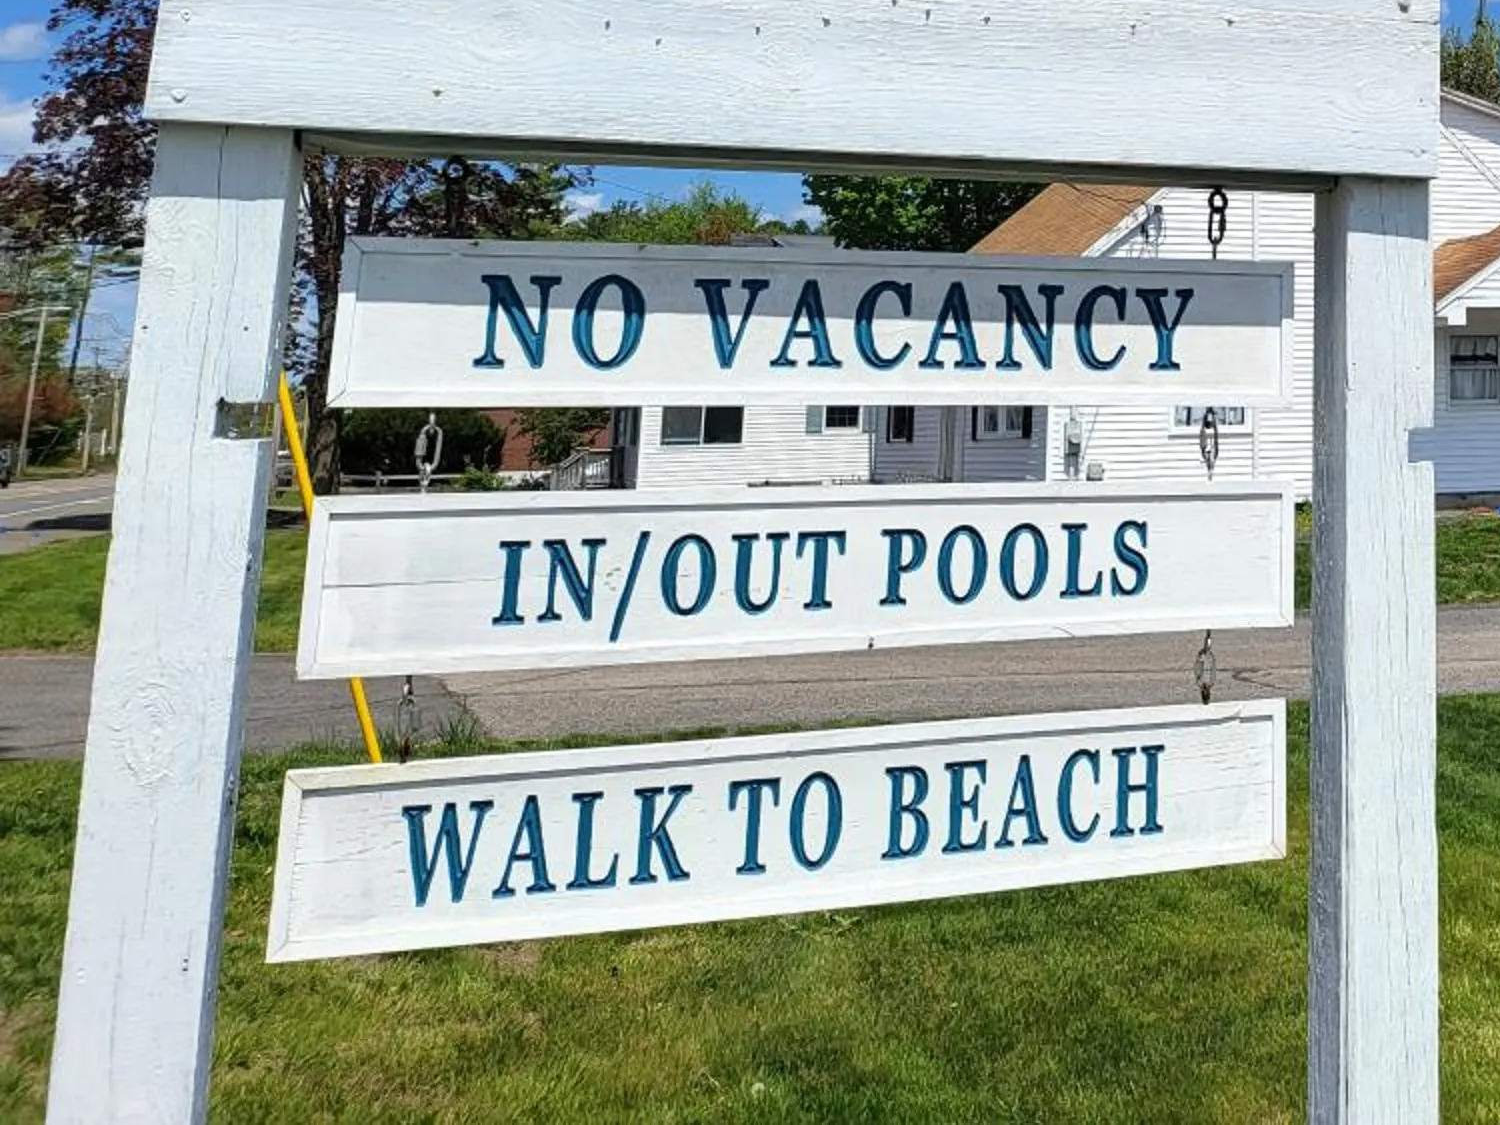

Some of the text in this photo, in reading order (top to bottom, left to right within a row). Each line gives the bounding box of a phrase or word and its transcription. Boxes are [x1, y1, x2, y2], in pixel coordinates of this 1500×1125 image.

[473, 274, 1195, 371] NO VACANCY
[492, 519, 1149, 642] IN/OUT POOLS
[402, 743, 1166, 907] WALK TO BEACH
